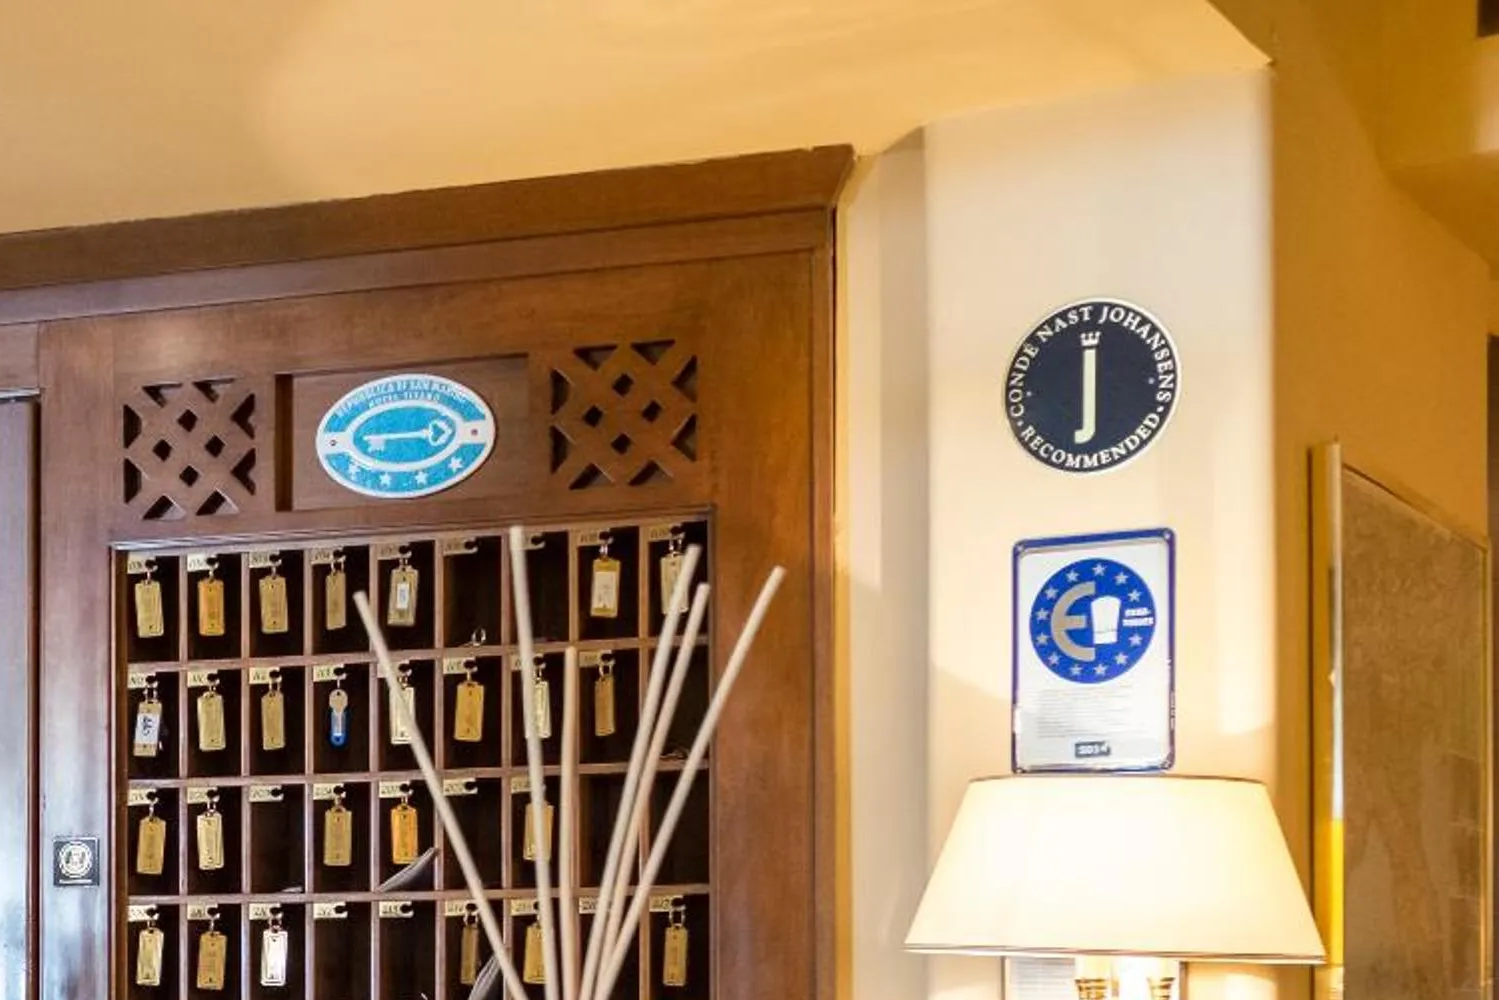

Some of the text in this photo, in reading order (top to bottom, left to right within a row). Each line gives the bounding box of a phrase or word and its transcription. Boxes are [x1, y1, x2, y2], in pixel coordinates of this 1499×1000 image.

[1008, 305, 1175, 418] CONDE NAST JOHANSENS
[1021, 412, 1160, 469] RECOMMENDED
